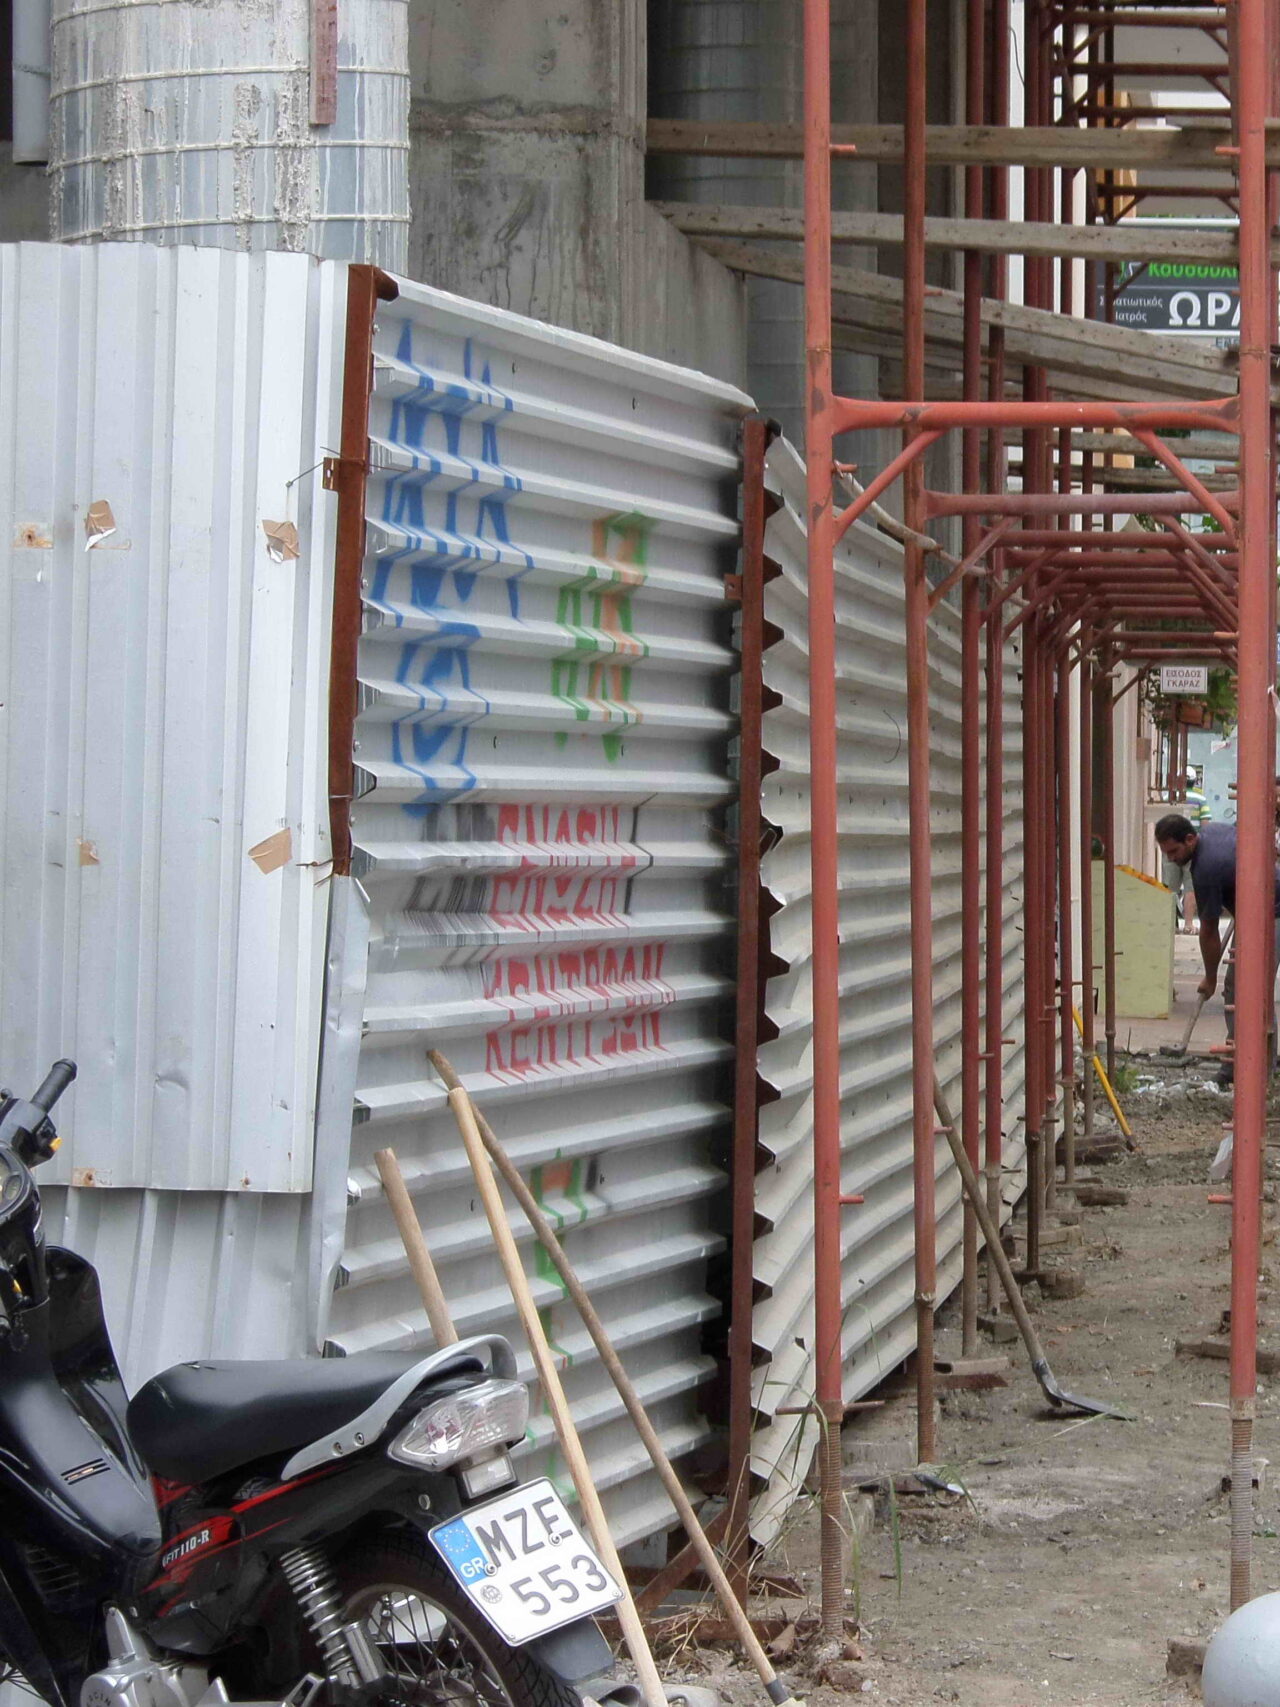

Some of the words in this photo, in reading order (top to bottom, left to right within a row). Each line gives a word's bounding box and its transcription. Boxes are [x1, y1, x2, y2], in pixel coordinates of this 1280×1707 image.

[1100, 295, 1164, 308] Σατιωτικός
[1115, 311, 1147, 323] Ιατρός
[1167, 679, 1201, 688] ΓΚΑΡΑΖ
[476, 1496, 574, 1568] MZE
[460, 1557, 484, 1578] GR
[509, 1554, 607, 1616] 553
